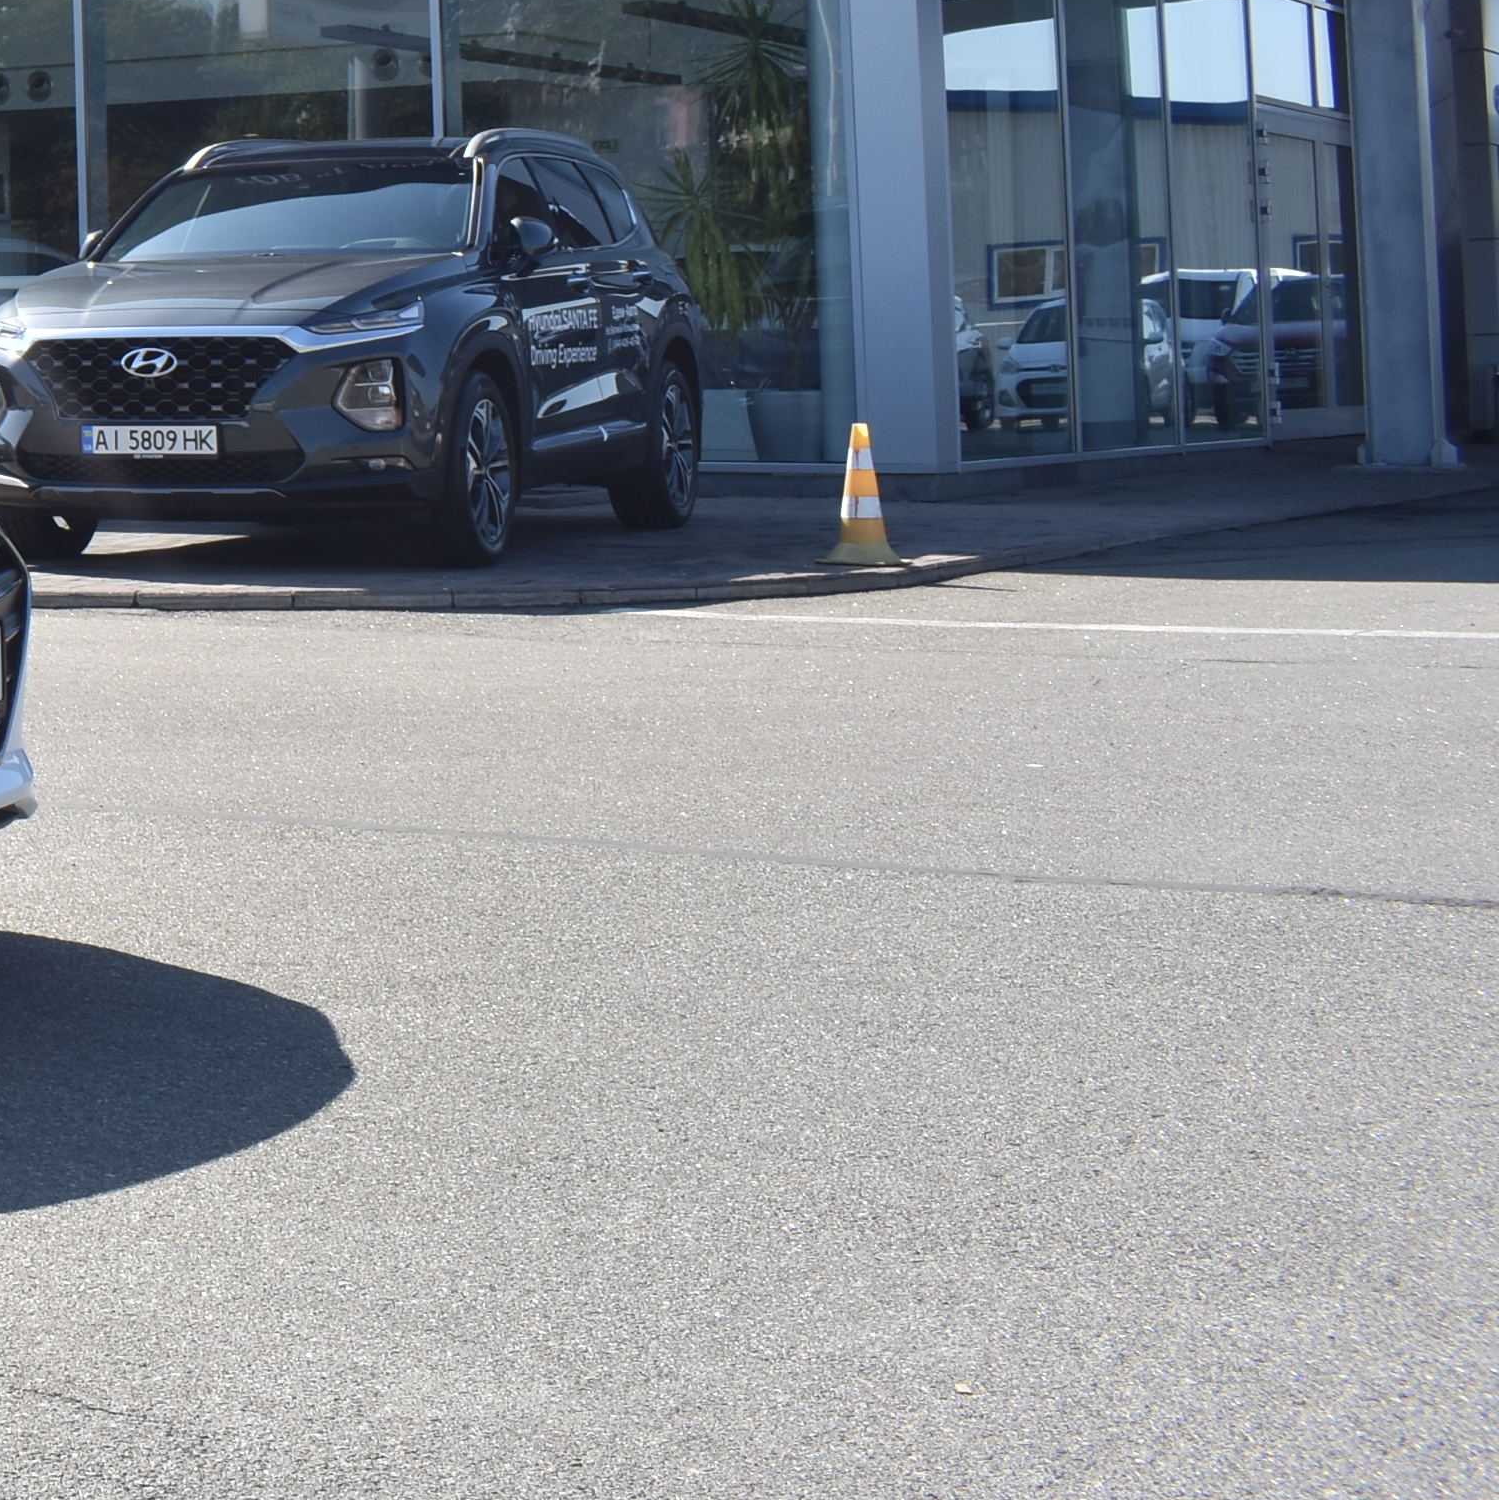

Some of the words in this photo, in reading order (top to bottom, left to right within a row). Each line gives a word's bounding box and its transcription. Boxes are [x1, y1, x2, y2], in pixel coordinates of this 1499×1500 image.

[530, 342, 558, 369] Driving
[558, 342, 598, 368] Experience
[95, 429, 119, 451] AI
[129, 429, 178, 451] 5809
[182, 429, 215, 451] HK
